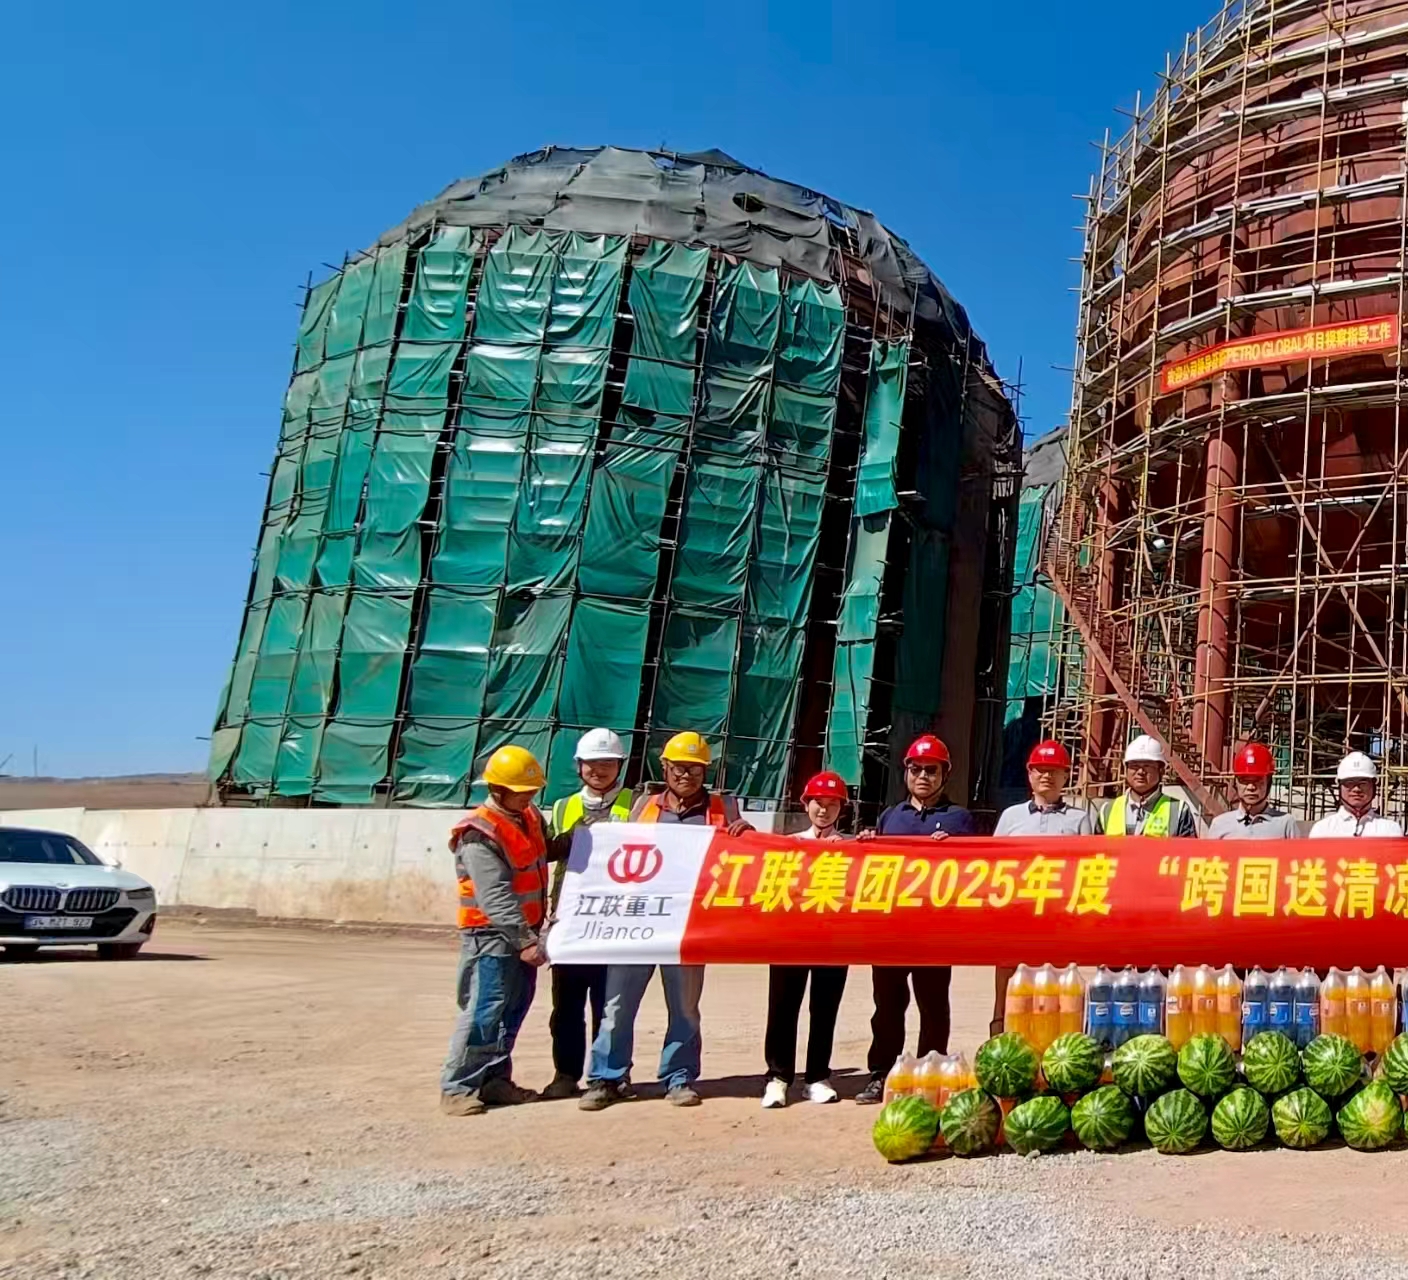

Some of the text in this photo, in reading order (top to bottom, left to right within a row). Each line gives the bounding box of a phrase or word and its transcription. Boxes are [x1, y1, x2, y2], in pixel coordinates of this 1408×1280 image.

[702, 850, 1118, 915] 江联集团2025年度
[573, 894, 673, 917] 江联重工
